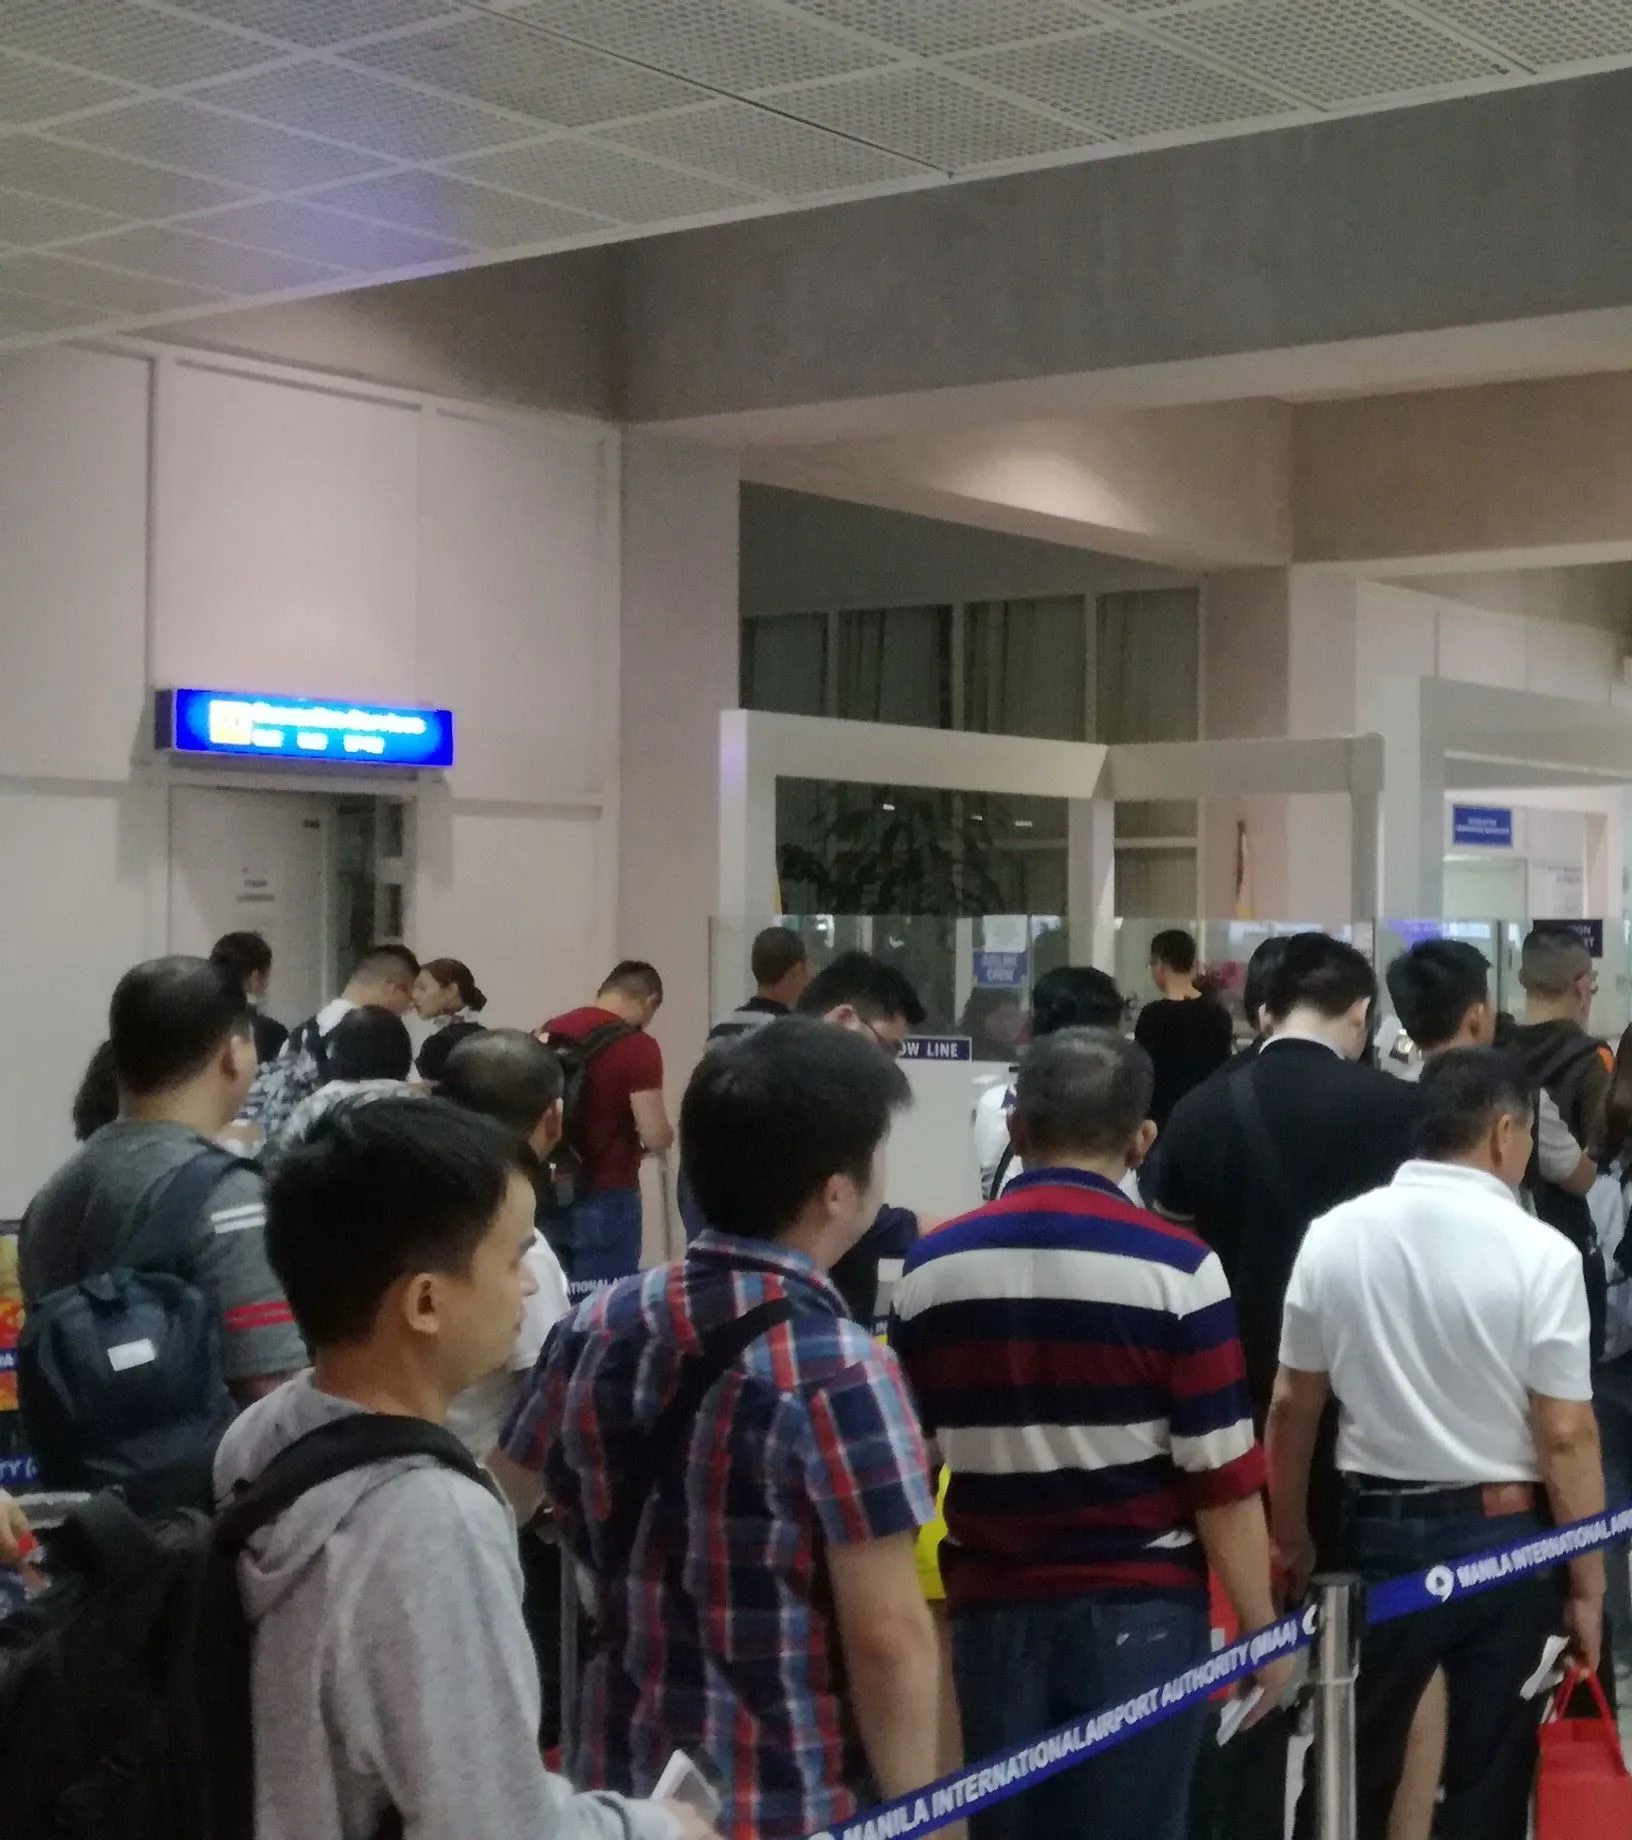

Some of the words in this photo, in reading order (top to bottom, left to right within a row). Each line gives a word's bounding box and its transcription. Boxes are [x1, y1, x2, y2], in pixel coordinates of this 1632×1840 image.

[927, 1042, 958, 1058] LINE
[842, 1798, 930, 1840] MANILA
[931, 1723, 1087, 1819] INTERNATIONAL
[1085, 1687, 1160, 1747] AIRPORT
[1161, 1642, 1250, 1707] AUTHORITY
